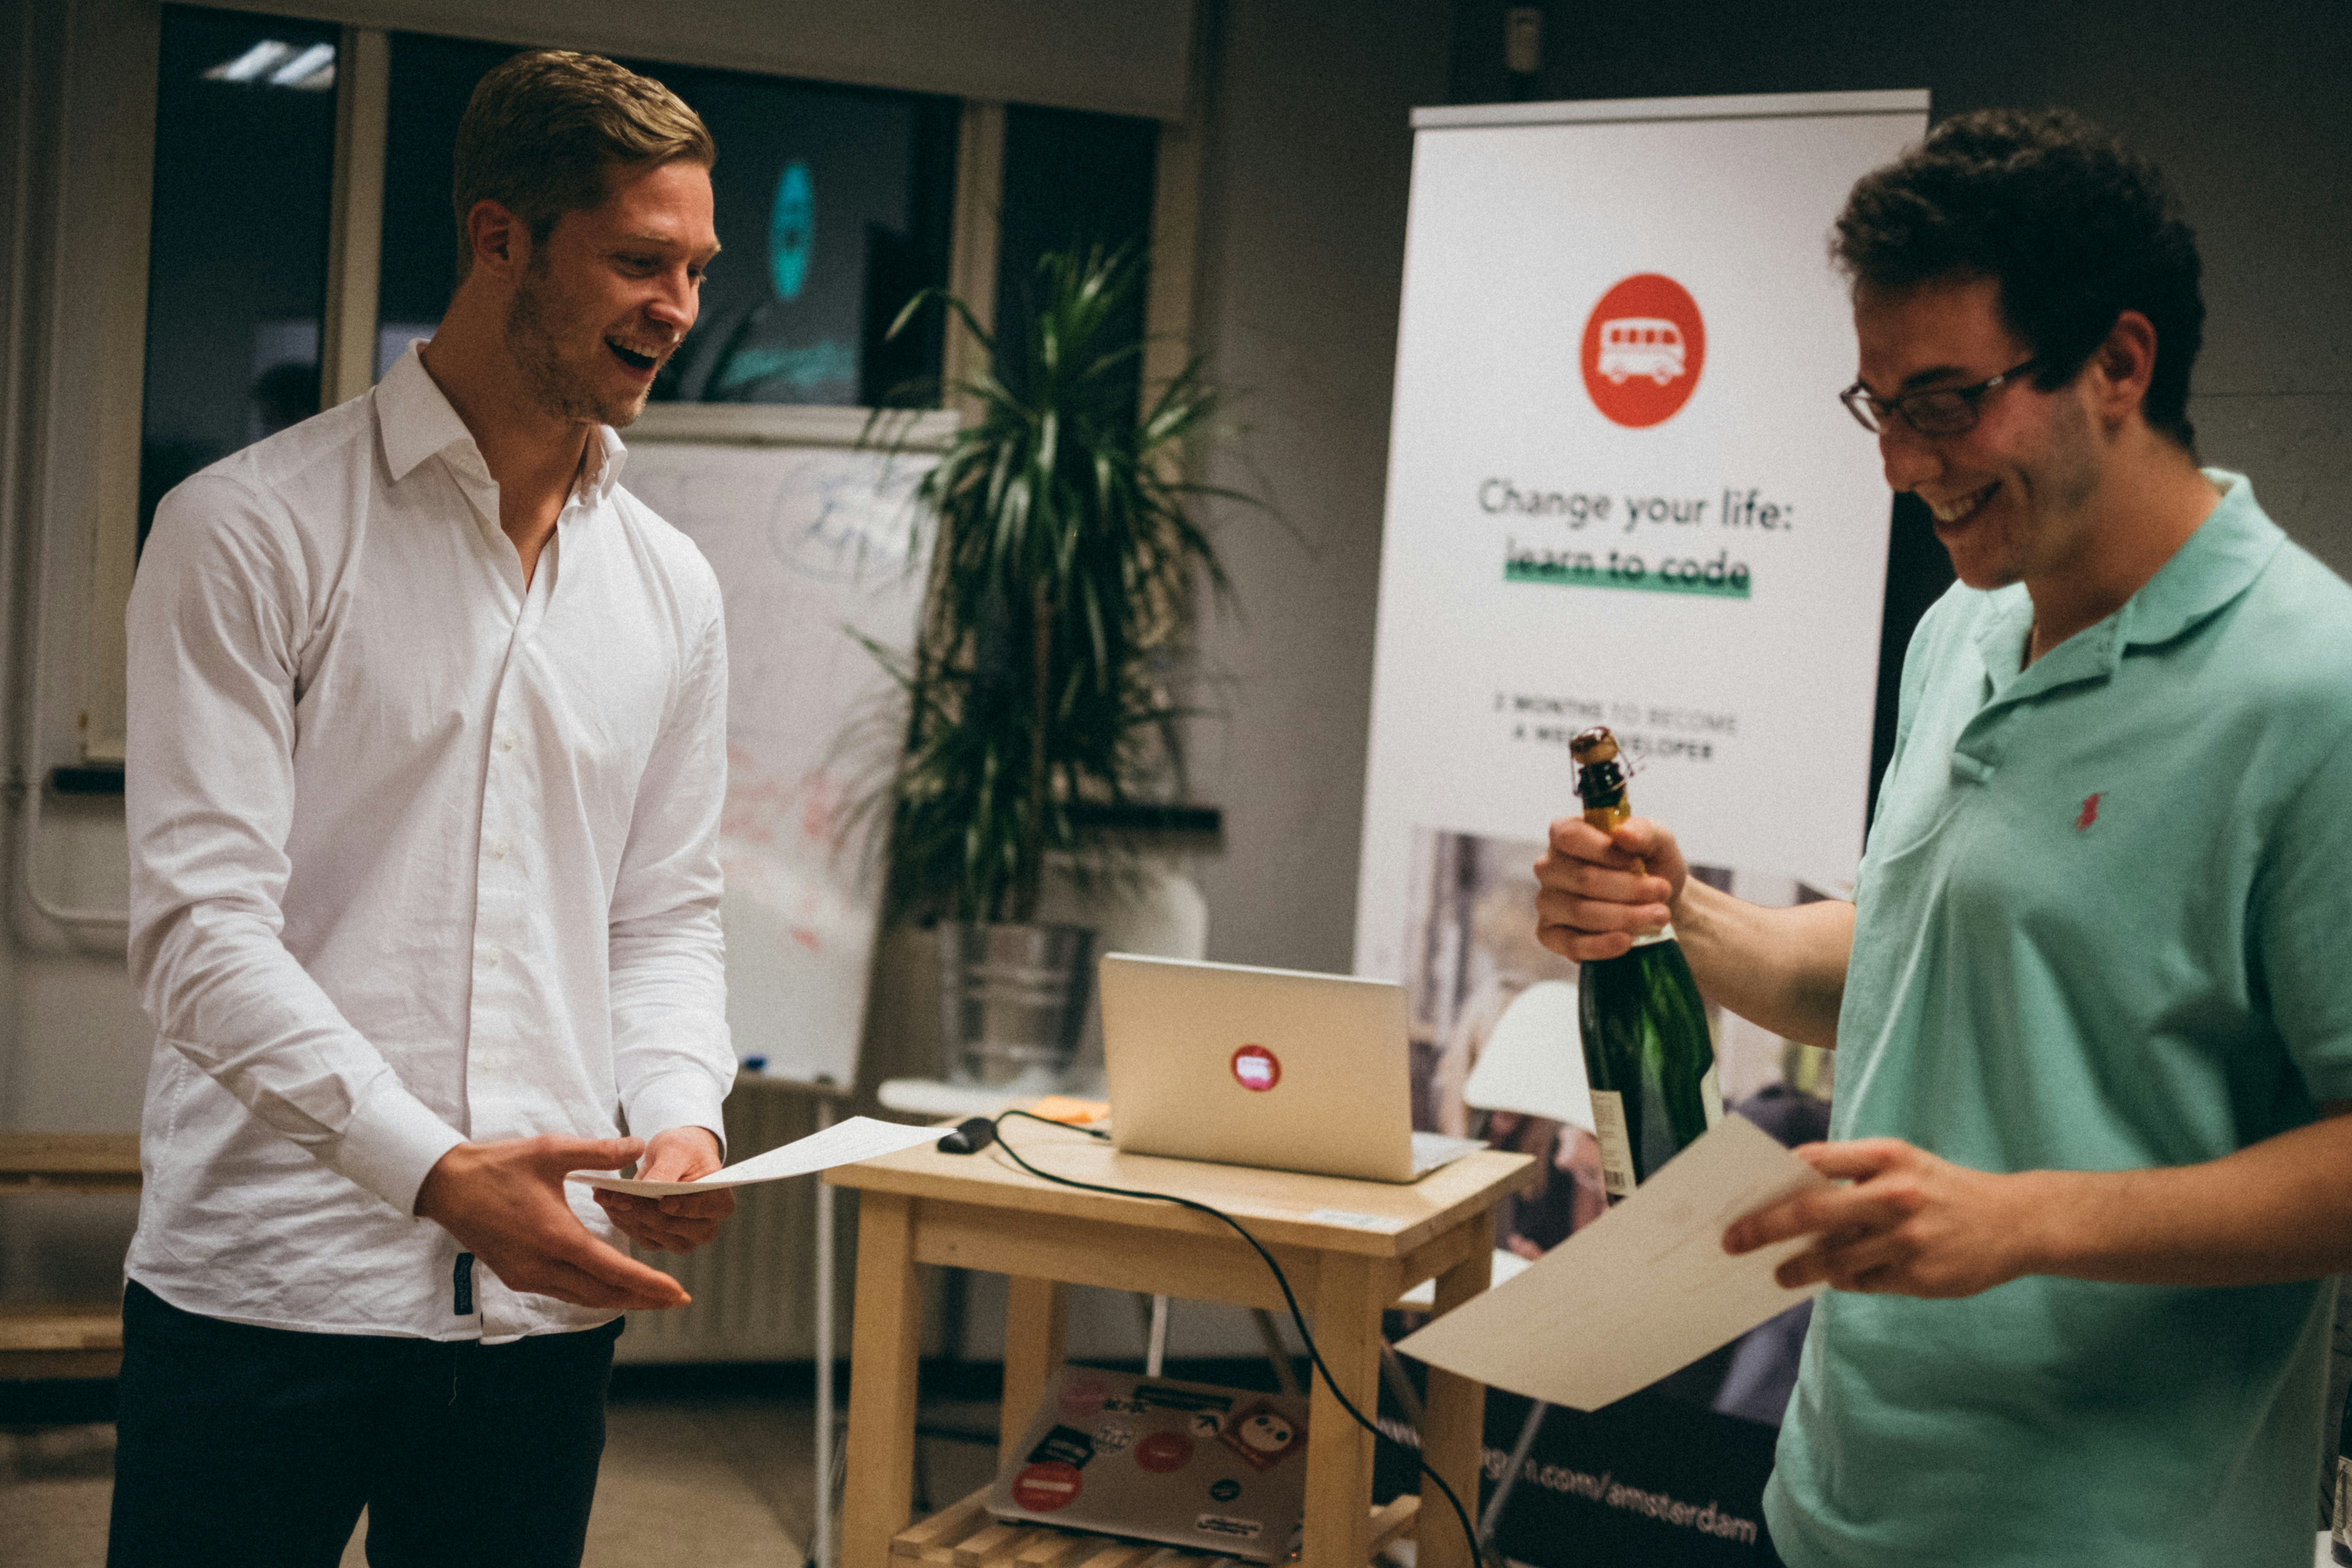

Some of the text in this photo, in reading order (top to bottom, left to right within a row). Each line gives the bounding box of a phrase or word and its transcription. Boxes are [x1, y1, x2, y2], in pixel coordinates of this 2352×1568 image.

[1478, 477, 1793, 533] Change your life:
[1504, 535, 1751, 591] learn to code
